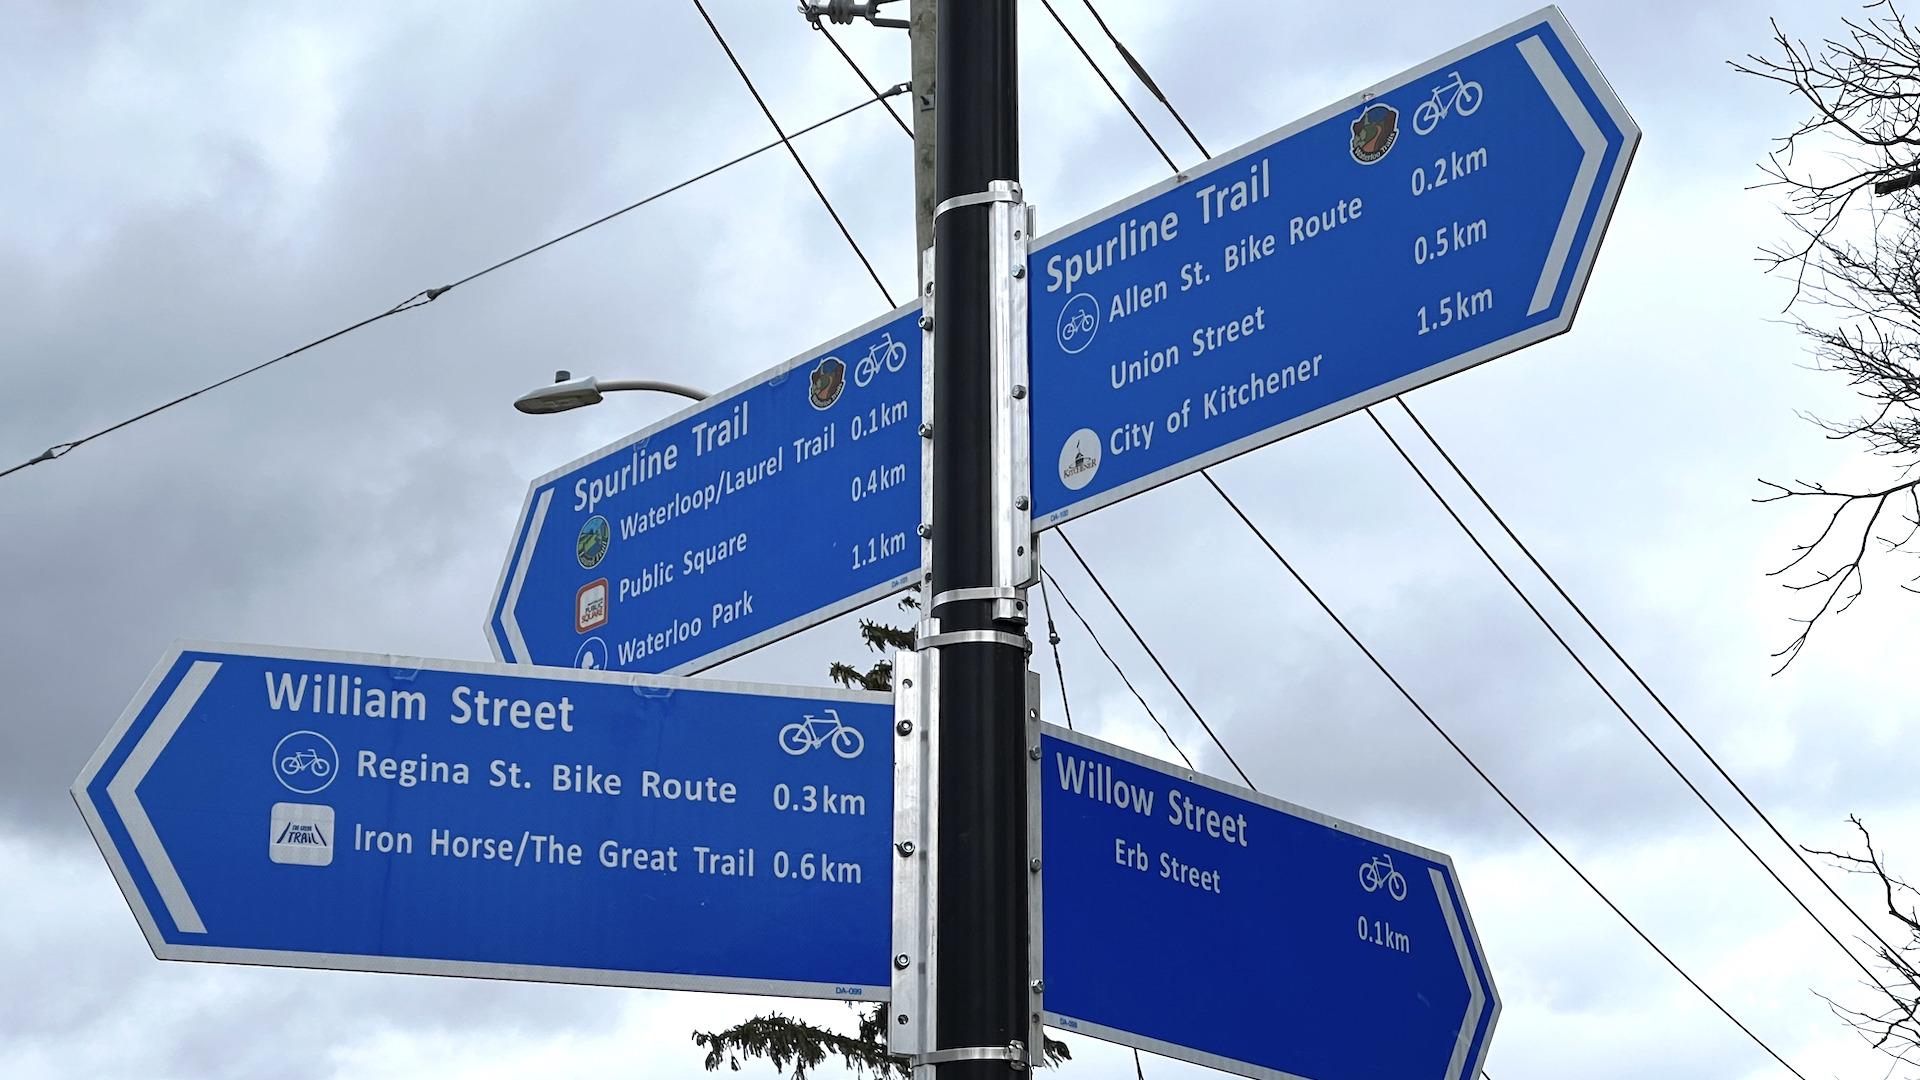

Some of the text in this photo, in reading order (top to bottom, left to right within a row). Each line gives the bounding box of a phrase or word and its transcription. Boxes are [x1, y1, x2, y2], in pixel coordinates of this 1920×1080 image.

[1046, 158, 1270, 295] Spurline Trail
[1109, 197, 1362, 323] Allen St. Bike Route
[1111, 306, 1265, 389] Union Street
[1110, 354, 1323, 455] City of Kitchener
[574, 400, 748, 515] Spurline Trail
[619, 422, 835, 542] Waterloop/Laurel Trail
[619, 533, 747, 603] Public Square
[618, 590, 753, 666] Waterloo Park
[265, 671, 574, 732] William Street
[357, 750, 737, 804] Regina St. Bike Route
[1057, 752, 1247, 847] Willow Street
[355, 823, 754, 877] Iron Horse/The Great Trail
[1116, 838, 1220, 893] Erb Street
